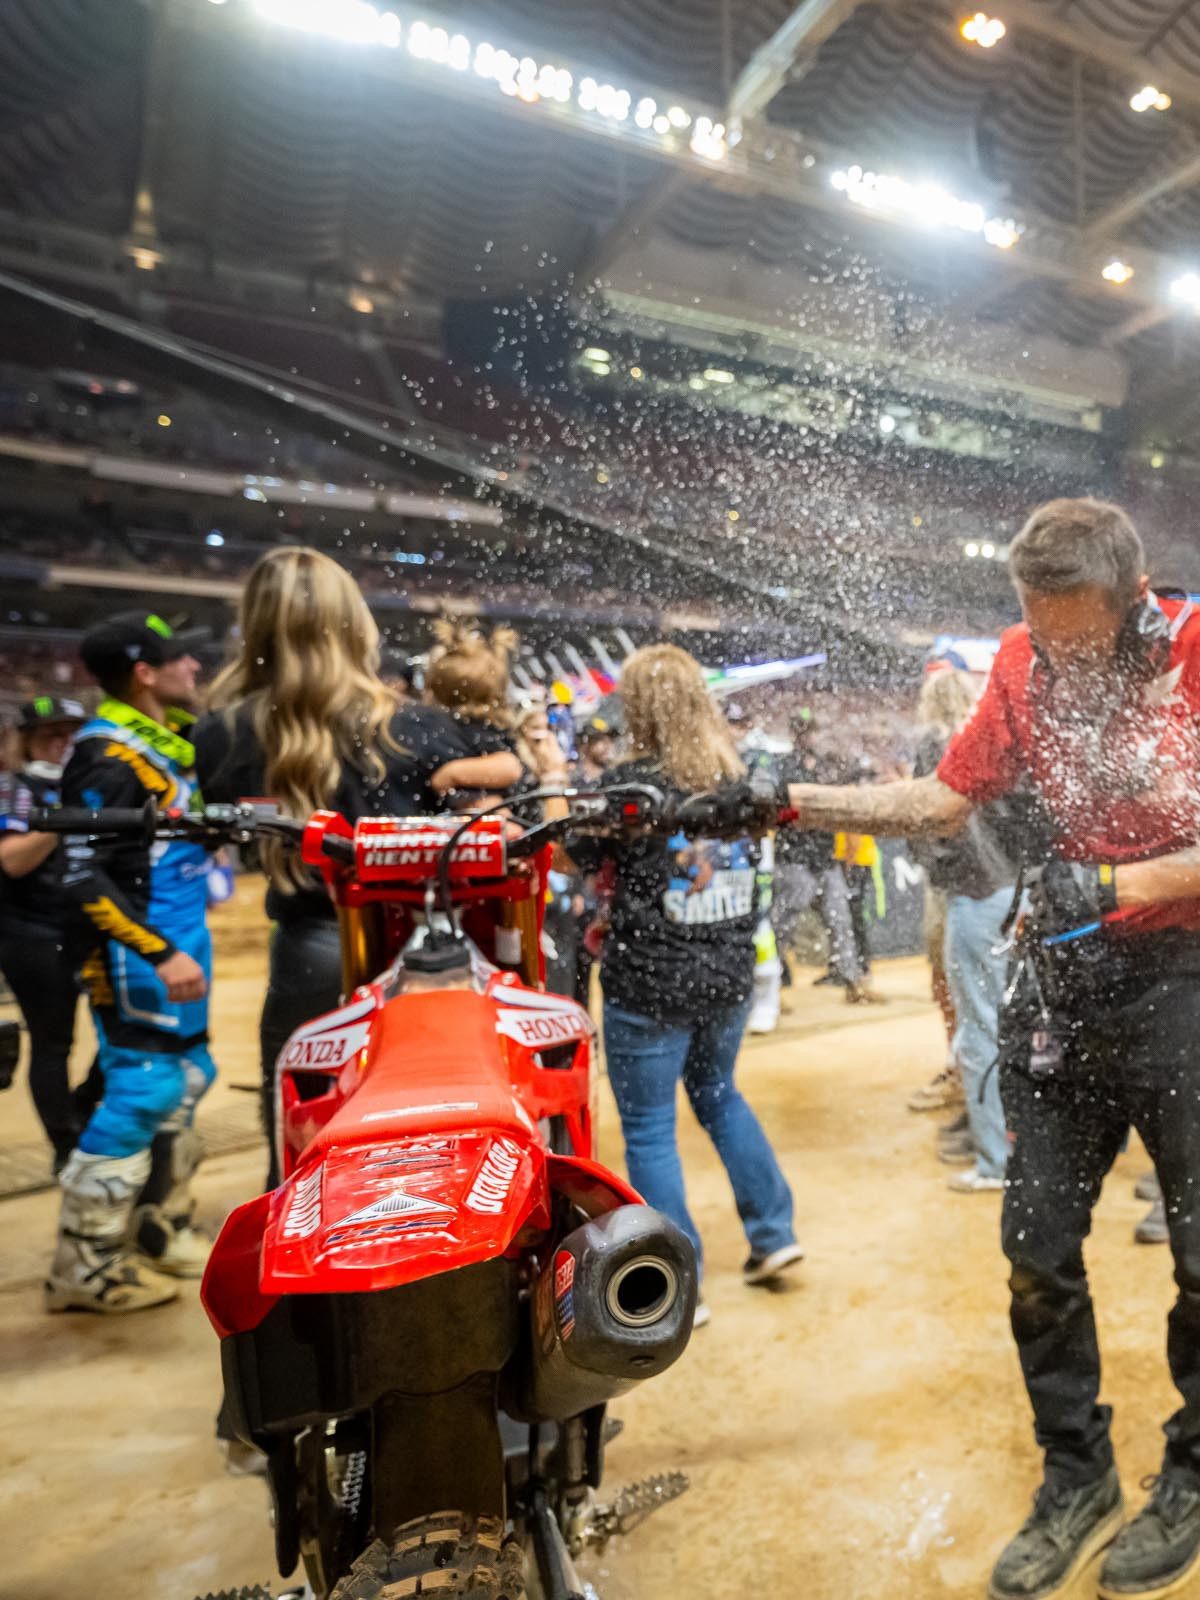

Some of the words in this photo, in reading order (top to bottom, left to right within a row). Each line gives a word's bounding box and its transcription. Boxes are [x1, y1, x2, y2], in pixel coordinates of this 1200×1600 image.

[516, 1013, 592, 1040] HOND
[278, 1038, 347, 1064] ONDA
[465, 1142, 520, 1213] DUNLOP
